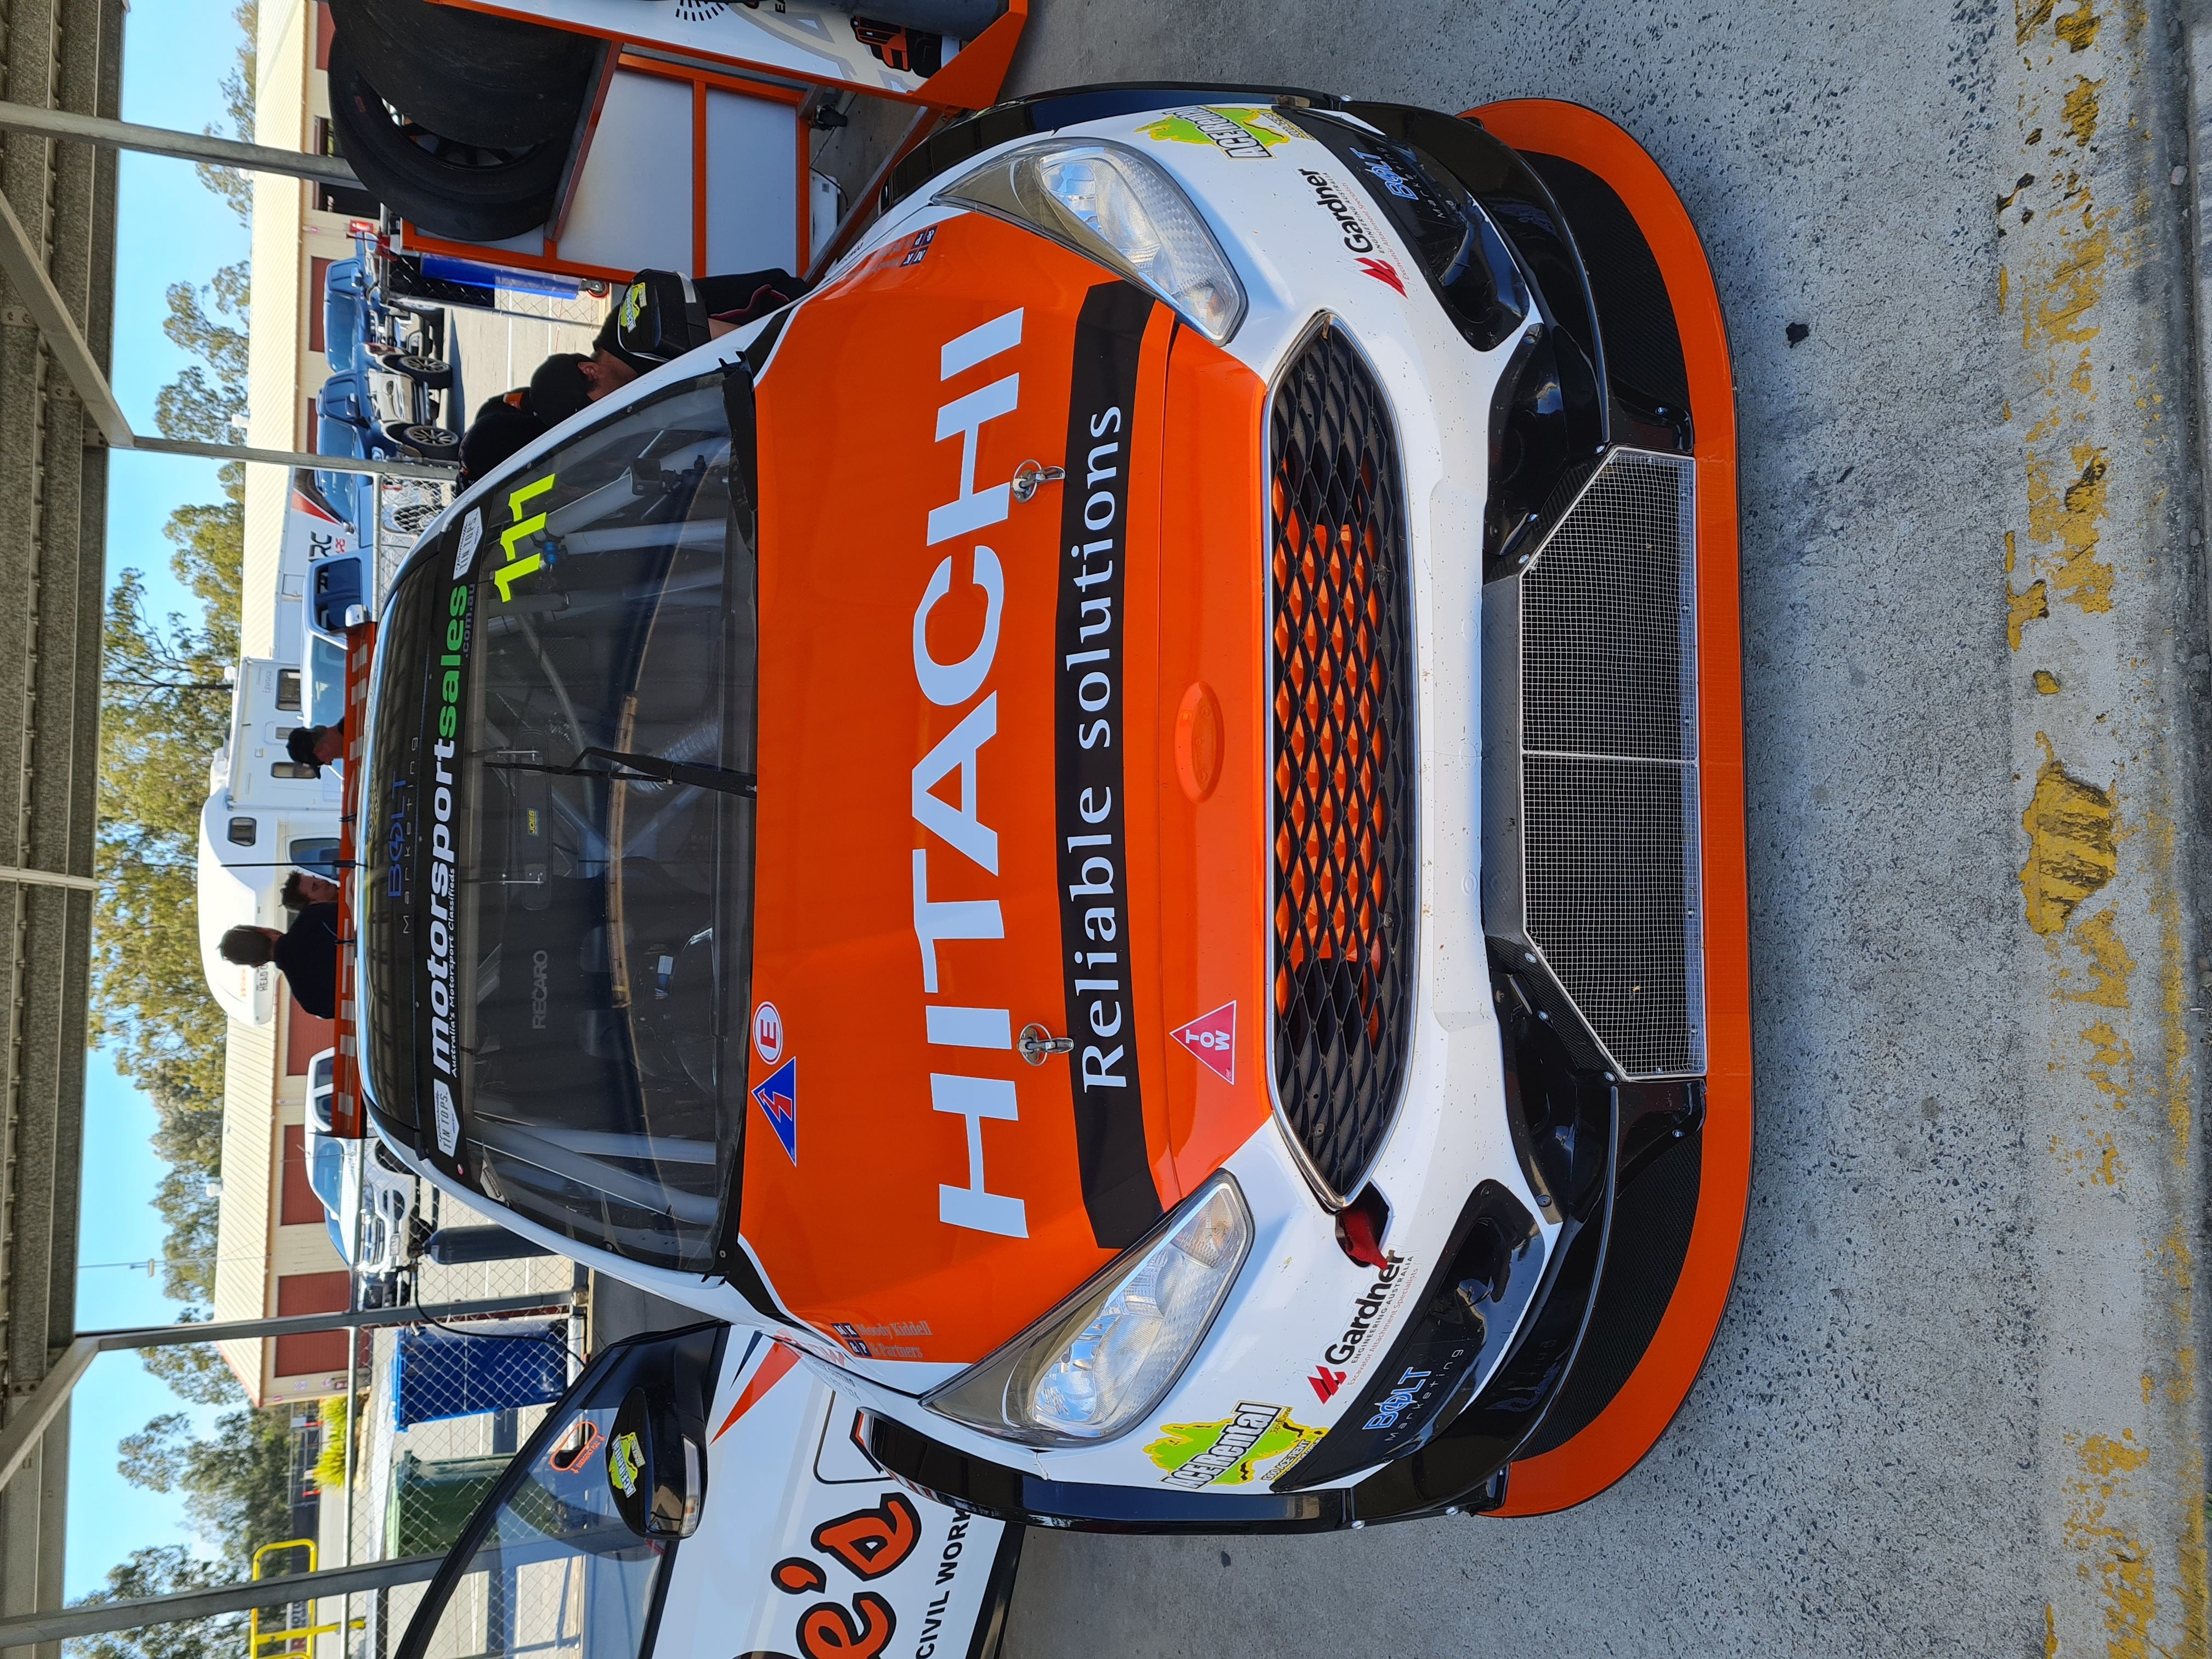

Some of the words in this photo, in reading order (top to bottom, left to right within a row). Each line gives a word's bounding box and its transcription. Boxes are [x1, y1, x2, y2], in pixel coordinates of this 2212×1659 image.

[1161, 106, 1244, 132] Rental
[1206, 131, 1273, 157] ACE
[1322, 172, 1352, 205] AUSTRALIA
[1341, 181, 1367, 211] Specialists
[1349, 146, 1419, 200] BOLT
[1376, 146, 1446, 218] Marketing
[1297, 168, 1373, 253] Gardner
[1350, 206, 1385, 253] ENGINEERING
[1362, 210, 1390, 247] Attachment
[1386, 245, 1410, 280] Excavator
[459, 550, 470, 571] TIN
[462, 517, 477, 548] TOPS
[494, 473, 555, 602] 111
[1066, 407, 1120, 749] solutions
[462, 583, 476, 658] .com.au
[912, 307, 1029, 1238] HITACHI
[388, 771, 407, 897] BOLT
[403, 736, 419, 934] Marketing
[447, 867, 456, 931] Classifieds
[448, 935, 456, 1008] Motorsport
[1068, 787, 1126, 1093] Reliable
[532, 950, 548, 1029] RECARO
[449, 1012, 458, 1078] Australia's
[1186, 1029, 1230, 1051] TOW
[439, 1093, 450, 1125] TOPS
[442, 1130, 452, 1148] TIN
[1324, 1249, 1405, 1364] Gardner
[1347, 1353, 1373, 1385] Excavator
[1369, 1310, 1398, 1352] Attachment
[1393, 1268, 1419, 1309] Specialists
[1351, 1308, 1388, 1363] ENGINEERING
[1386, 1255, 1414, 1305] AUSTRALIA
[877, 1342, 924, 1358] Partners
[1362, 1366, 1432, 1430] BOLT
[1384, 1349, 1464, 1441] Marketing
[611, 1437, 628, 1475] Rental
[1189, 1402, 1283, 1467] Rental
[1261, 1469, 1282, 1481] 1300
[1275, 1457, 1294, 1470] ACE
[1286, 1439, 1311, 1458] RENT
[620, 1472, 635, 1495] ACE
[1160, 1463, 1225, 1488] ACE
[916, 1590, 950, 1659] CIVIL
